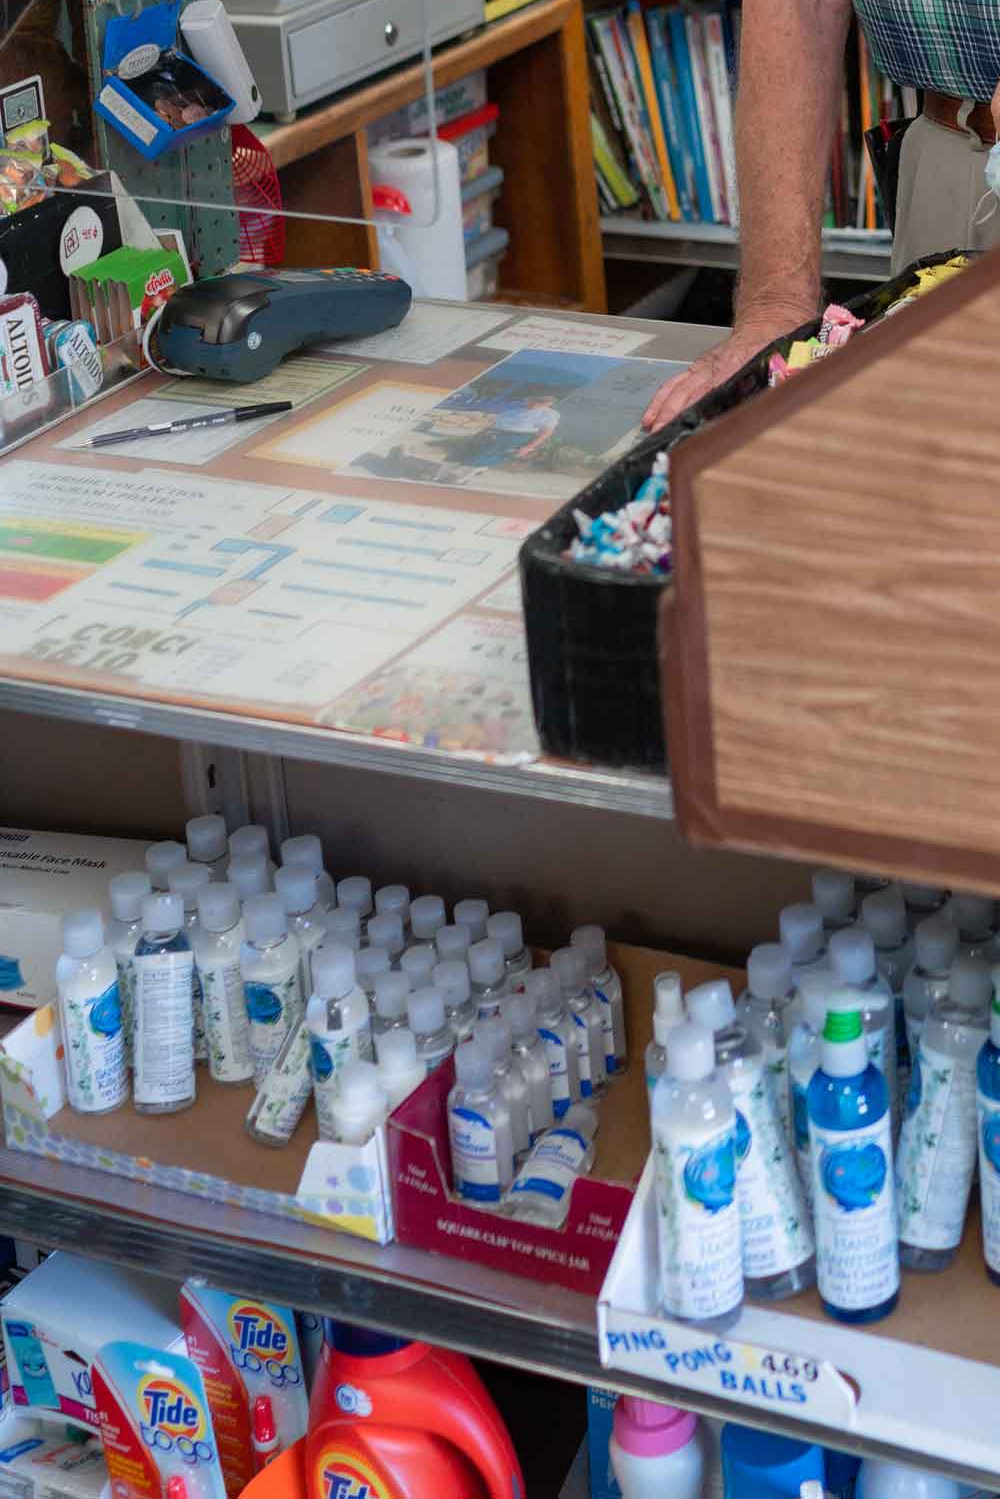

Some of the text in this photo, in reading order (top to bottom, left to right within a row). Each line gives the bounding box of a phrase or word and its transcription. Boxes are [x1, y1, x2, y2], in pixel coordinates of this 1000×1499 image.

[7, 318, 40, 406] ALTOIDS
[68, 332, 105, 385] ALTOIDS
[40, 853, 71, 865] Face
[71, 857, 106, 869] Mask
[233, 1315, 289, 1351] Tide
[606, 1329, 667, 1353] PING
[664, 1342, 733, 1373] PONG
[266, 1360, 301, 1390] go
[720, 1369, 808, 1404] BALLS
[143, 1390, 199, 1427] Tide
[177, 1435, 214, 1469] go
